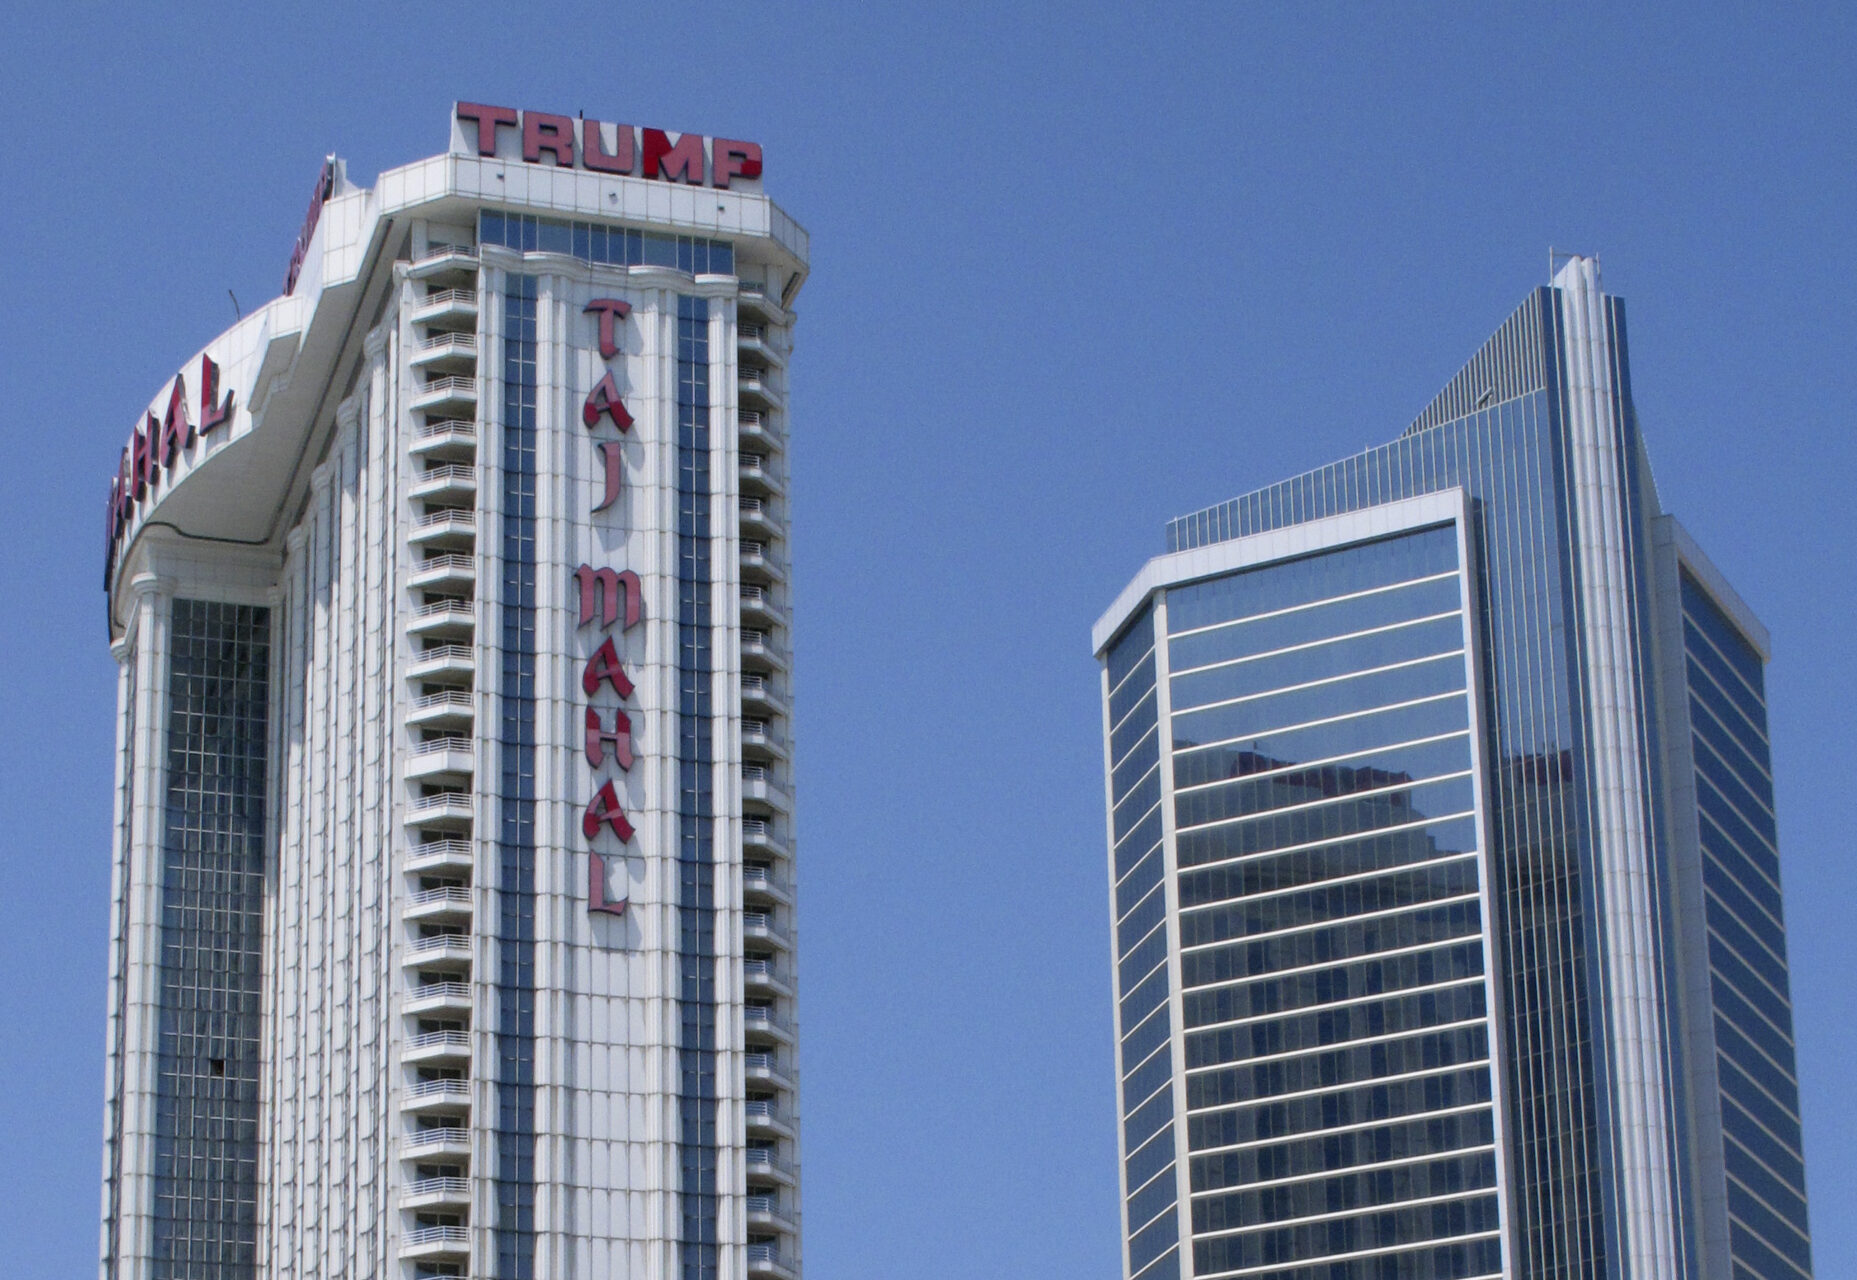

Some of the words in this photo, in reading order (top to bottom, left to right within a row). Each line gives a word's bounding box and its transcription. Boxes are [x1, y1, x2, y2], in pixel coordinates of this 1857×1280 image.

[456, 100, 763, 190] TRUMP
[582, 298, 635, 514] TAJ
[573, 562, 641, 916] MAHAL
